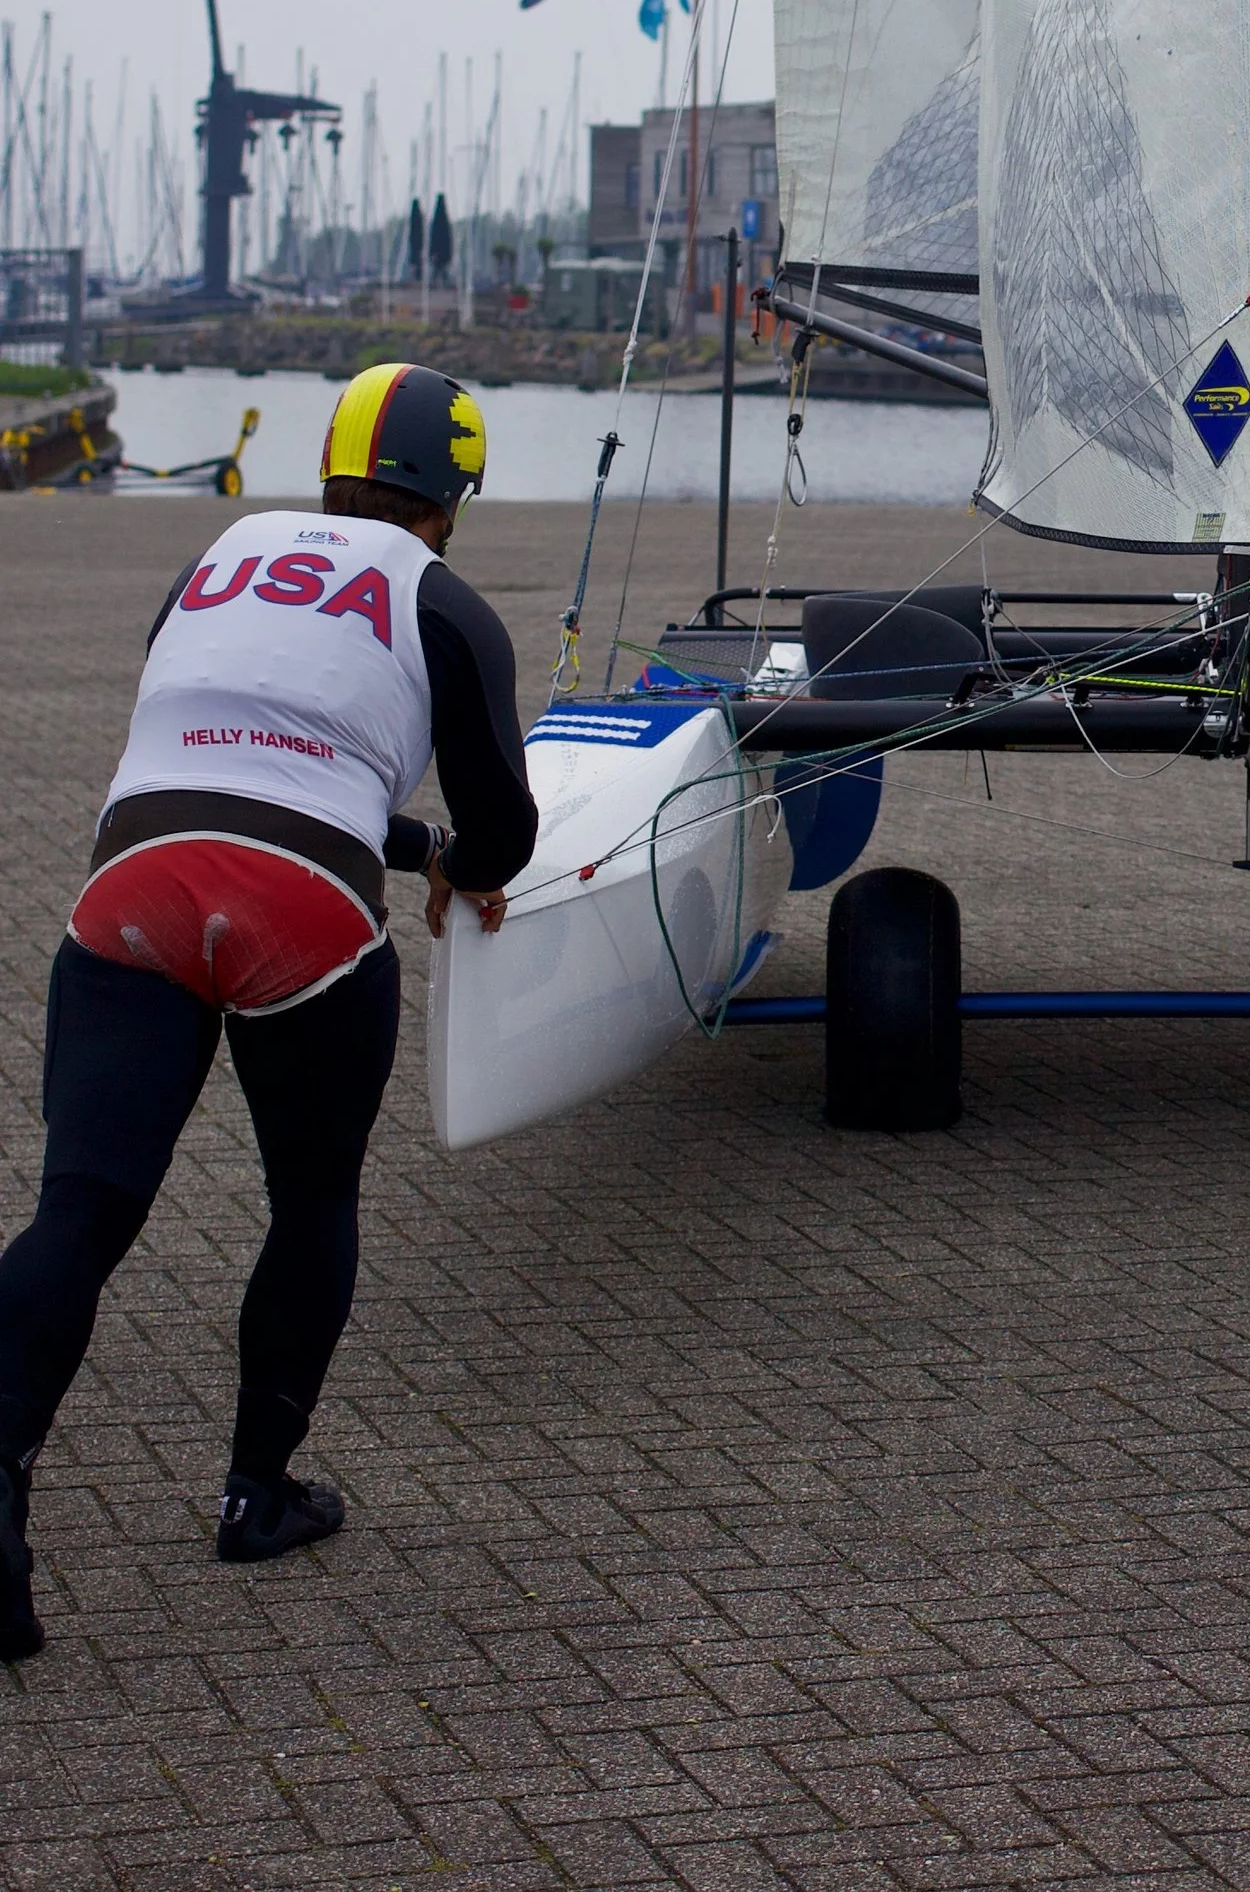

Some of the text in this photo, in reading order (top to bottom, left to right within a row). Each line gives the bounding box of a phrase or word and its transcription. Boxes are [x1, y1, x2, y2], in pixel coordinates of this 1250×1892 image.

[1194, 394, 1240, 402] Performance
[179, 552, 393, 652] USA
[182, 728, 336, 760] HELLY HANSEN
